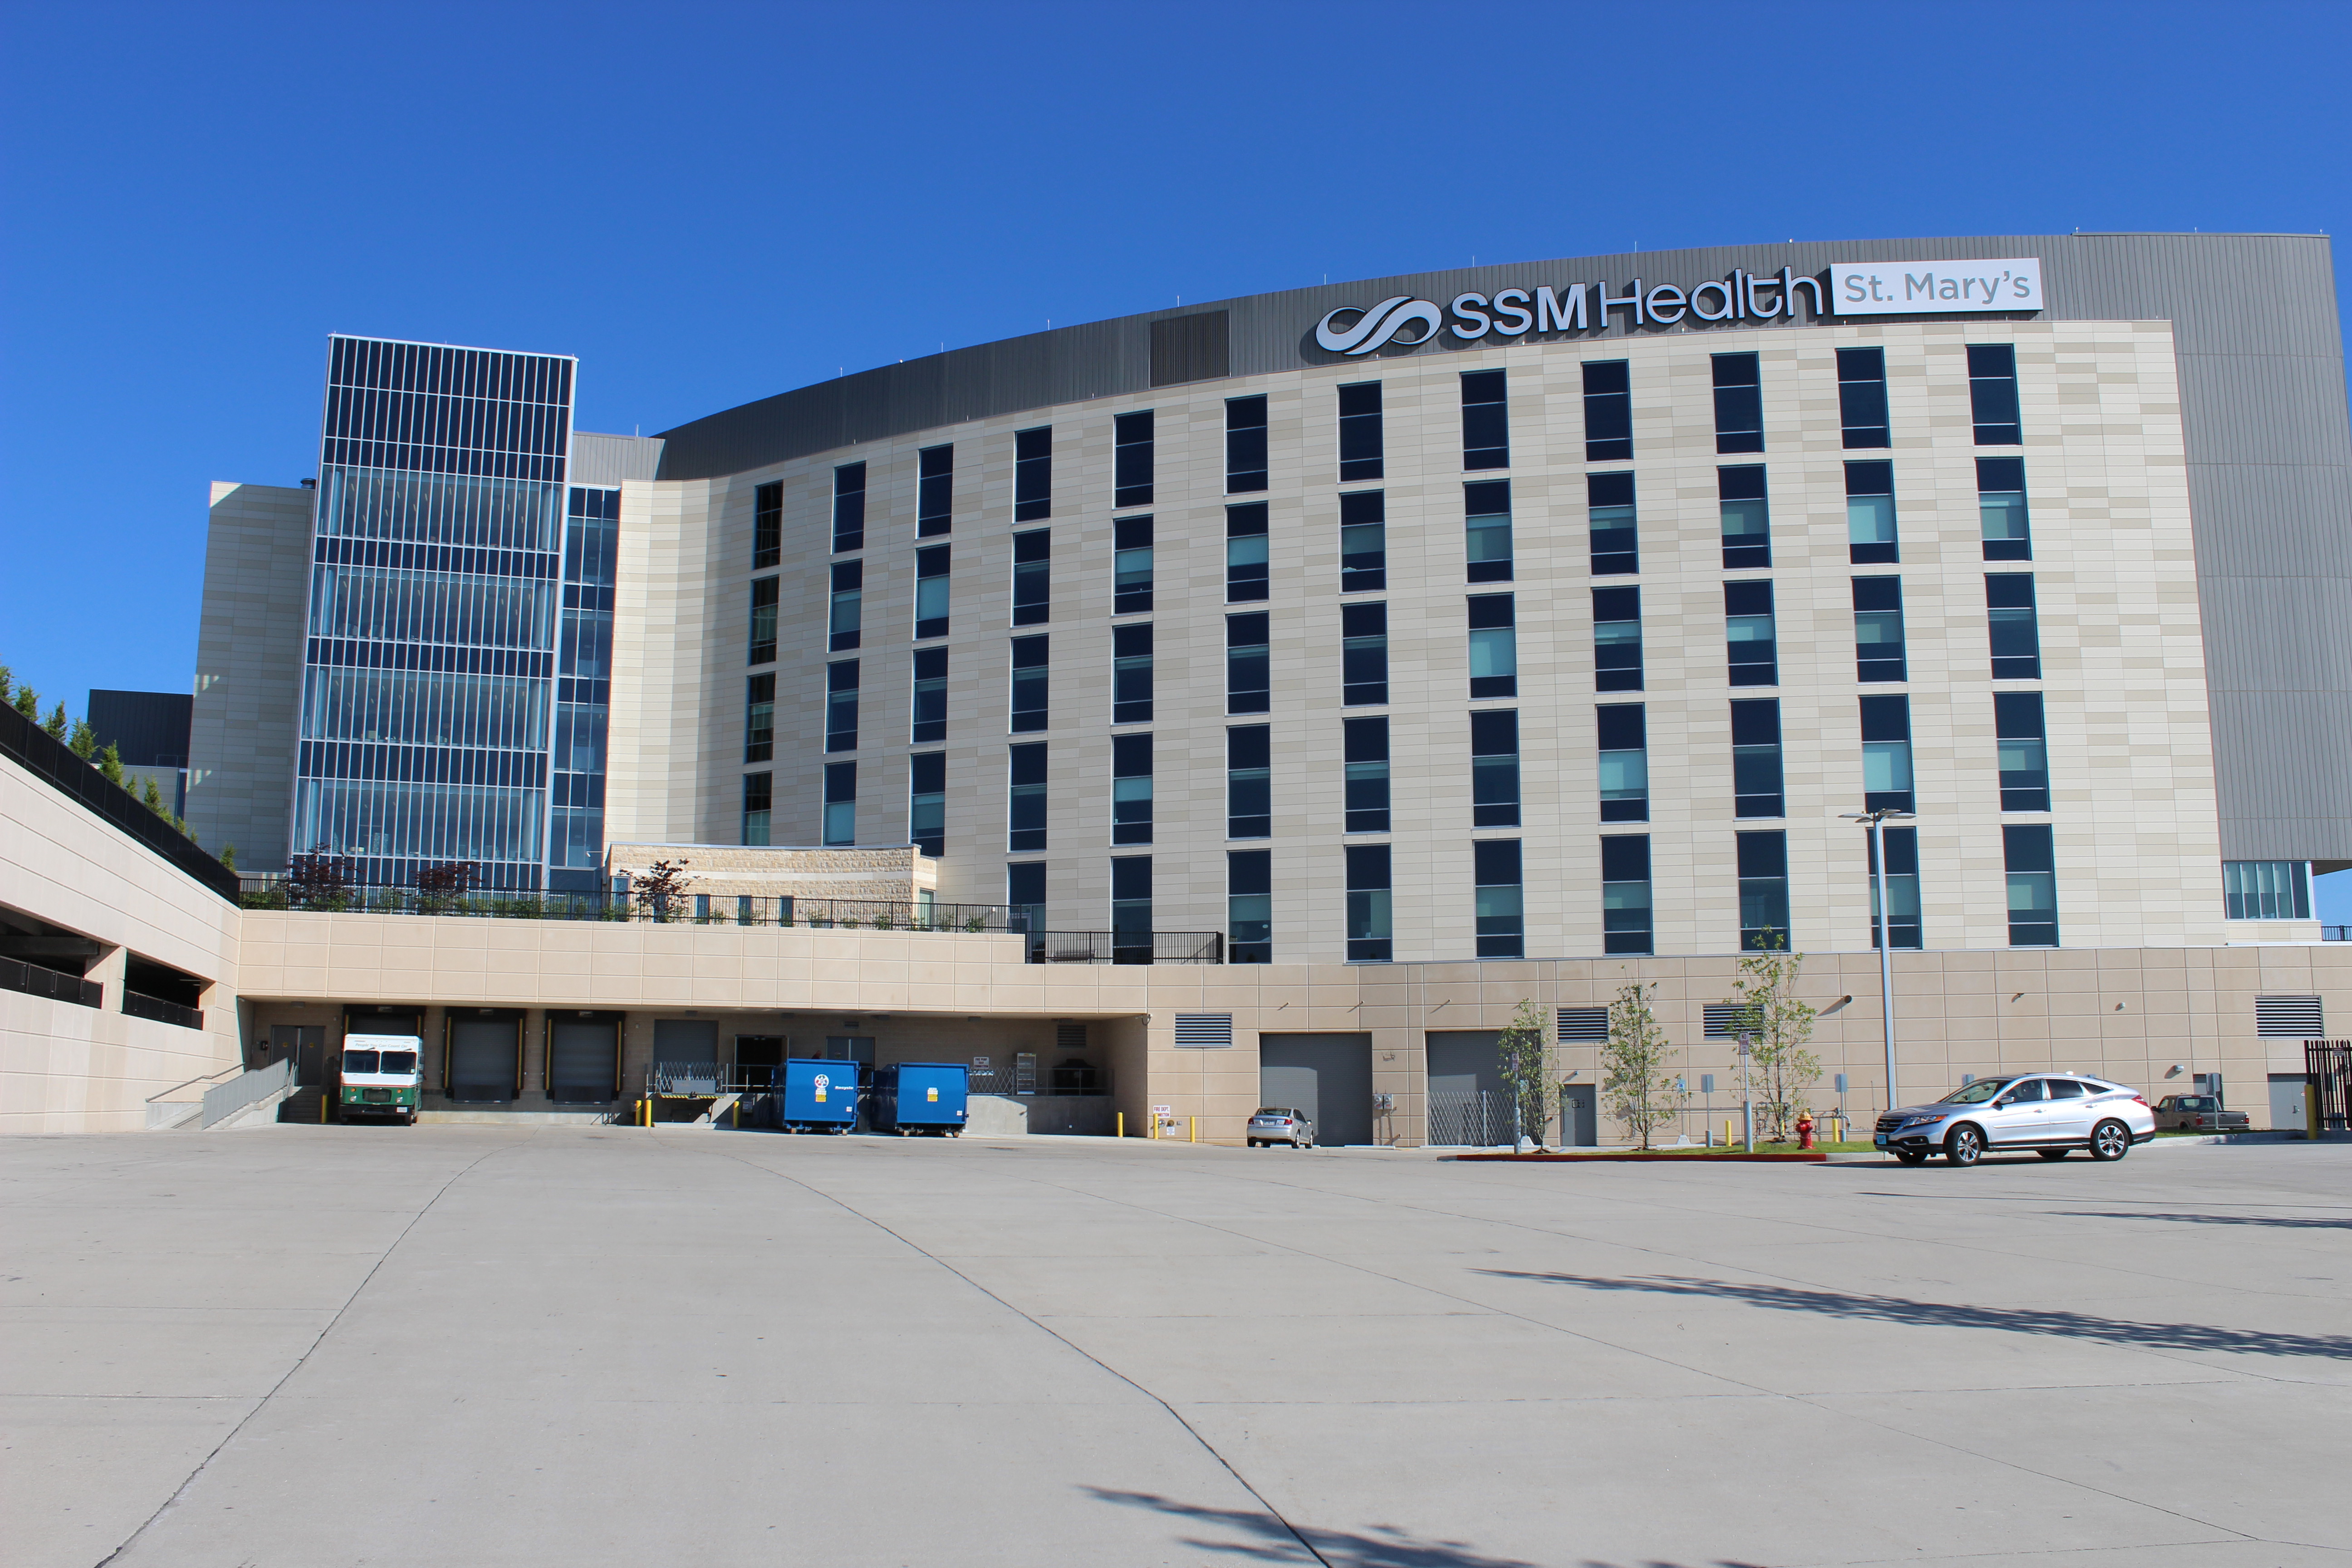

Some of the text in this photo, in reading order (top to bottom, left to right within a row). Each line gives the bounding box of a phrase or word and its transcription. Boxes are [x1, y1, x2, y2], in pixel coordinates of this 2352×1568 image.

[1451, 265, 1824, 339] SSM Health
[1844, 270, 2030, 305] St. Mary's
